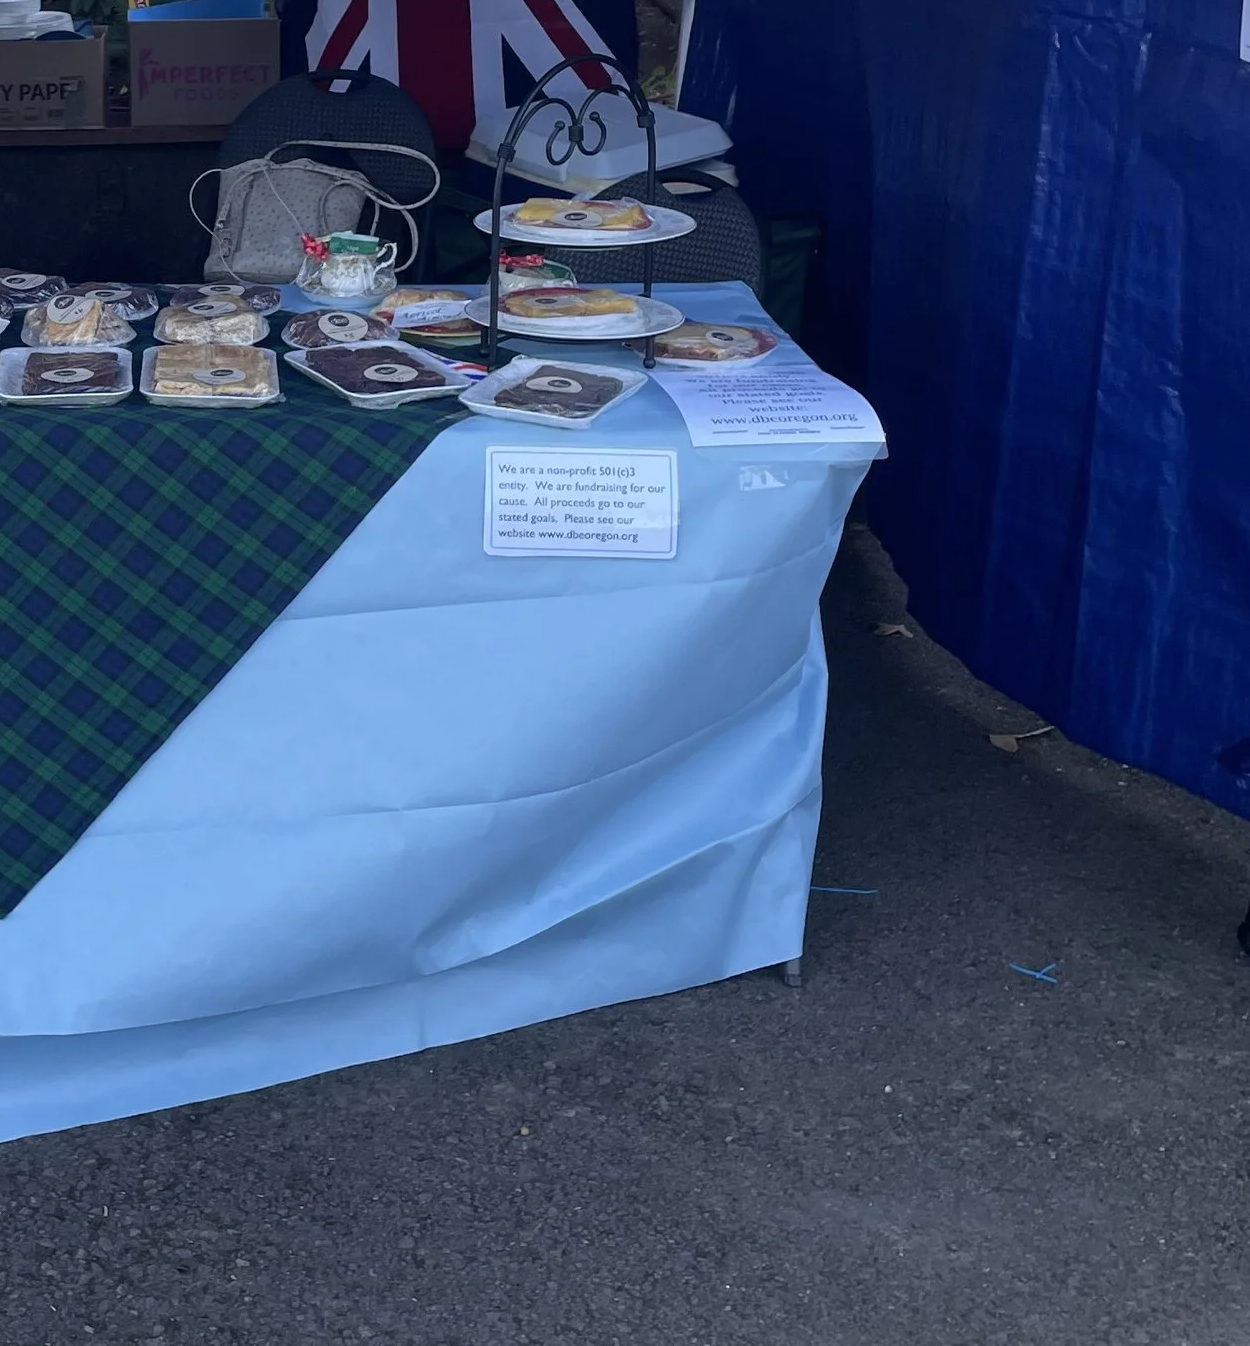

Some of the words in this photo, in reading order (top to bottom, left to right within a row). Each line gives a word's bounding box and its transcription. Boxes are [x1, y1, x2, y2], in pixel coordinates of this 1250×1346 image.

[499, 464, 517, 475] We
[519, 466, 536, 475] are
[546, 465, 597, 478] non-profit
[599, 466, 636, 478] 501(c)3
[498, 481, 528, 492] entity.
[535, 481, 554, 491] We
[556, 483, 572, 492] are
[575, 482, 628, 495] fundraising
[630, 483, 645, 493] for
[647, 485, 666, 494] our
[498, 498, 528, 507] cause.
[534, 497, 548, 507] All
[550, 497, 595, 509] proceeds
[598, 500, 610, 511] go
[613, 499, 624, 509] to
[627, 501, 646, 509] our
[498, 513, 528, 522] stated
[531, 514, 559, 524] goals.
[564, 514, 595, 524] Please
[597, 516, 614, 525] see
[617, 517, 635, 525] our
[498, 529, 536, 539] website
[538, 530, 639, 543] www.dbeoregon.org
